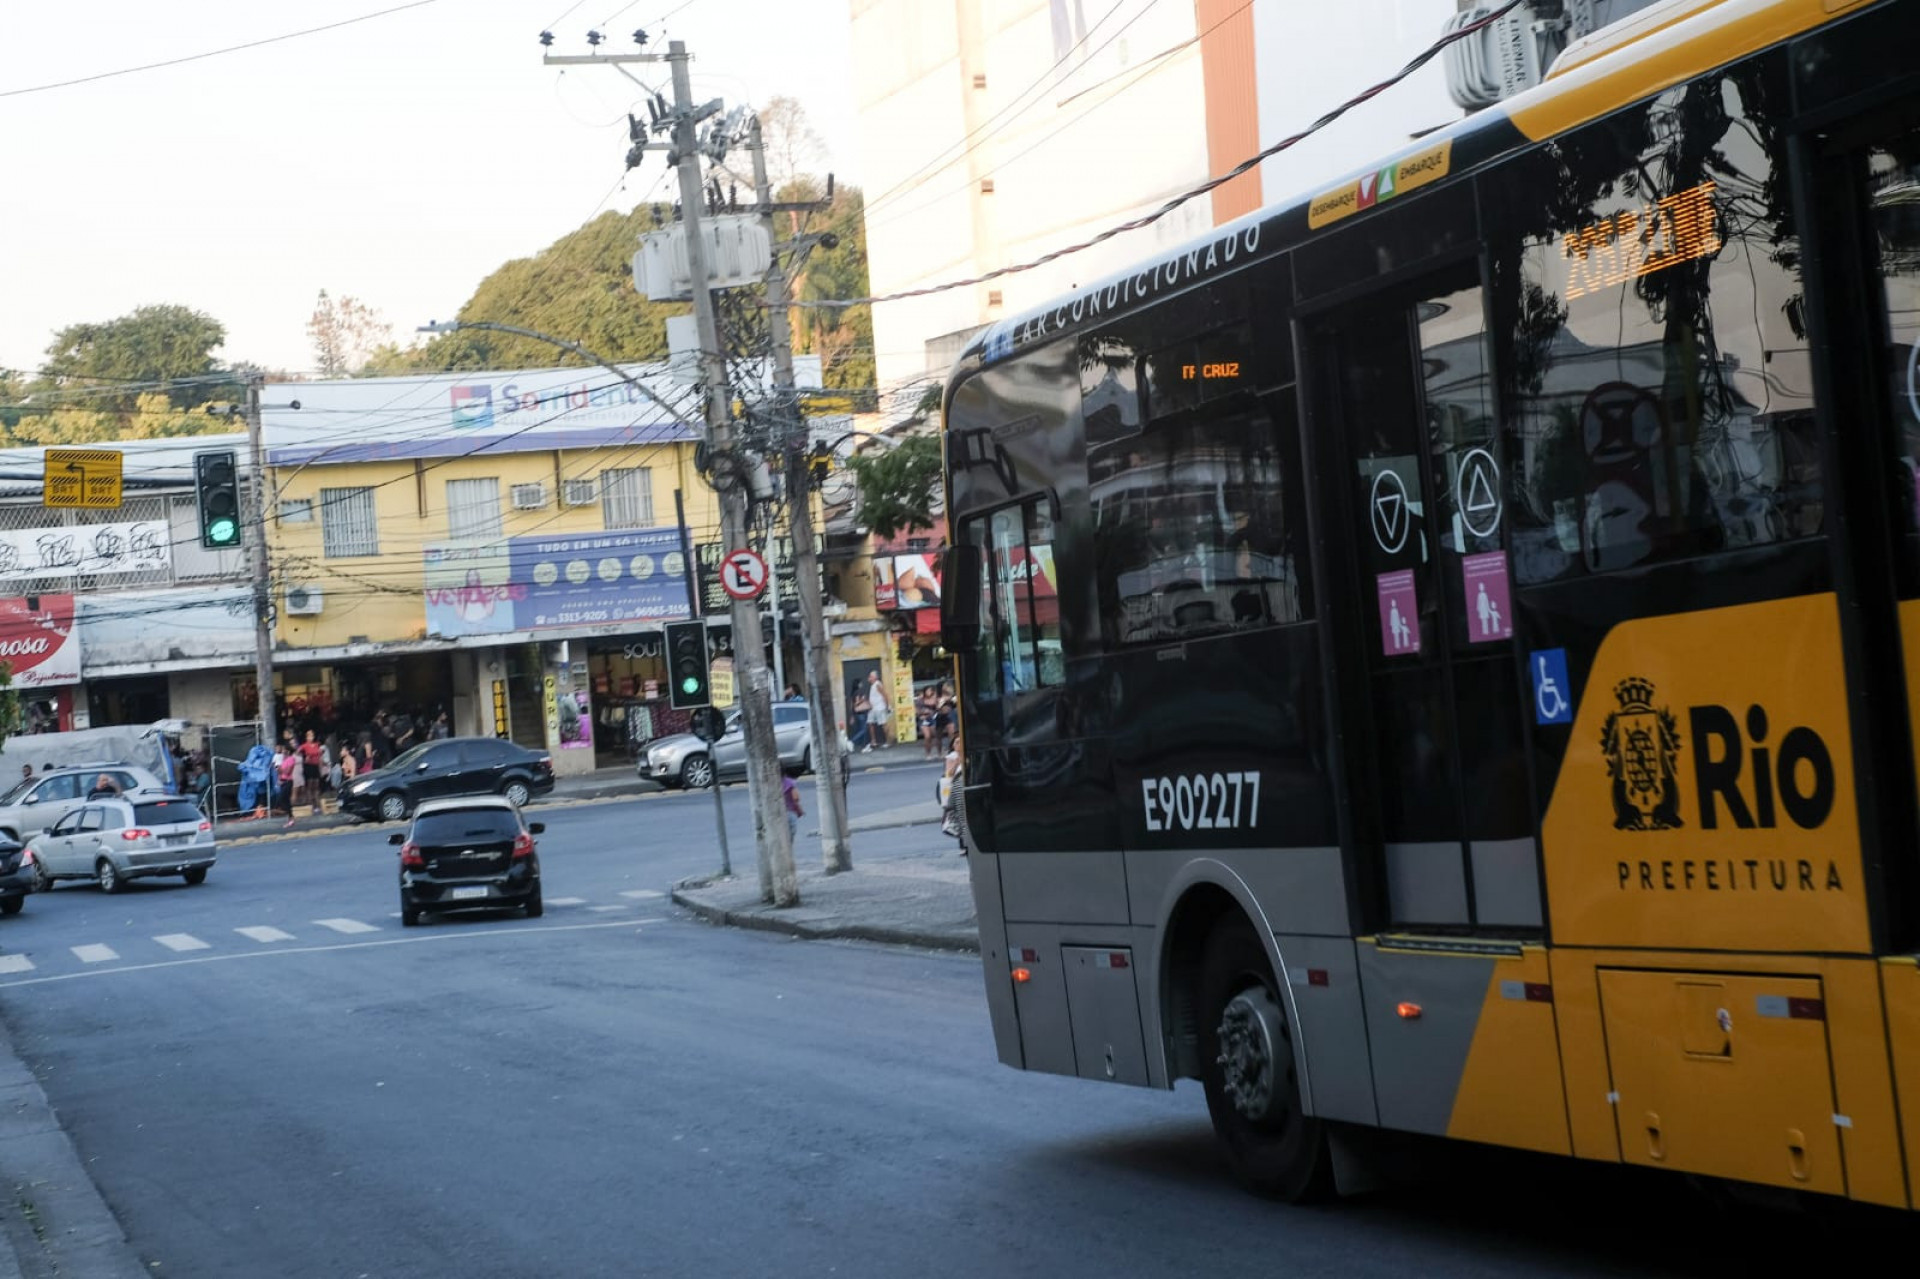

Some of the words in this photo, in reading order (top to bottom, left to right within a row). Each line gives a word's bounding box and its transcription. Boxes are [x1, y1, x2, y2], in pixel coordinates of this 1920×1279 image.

[1400, 151, 1443, 180] EMBARQUE
[1312, 189, 1357, 218] DESEMBARQUE
[1021, 312, 1047, 343] AR
[1056, 222, 1261, 328] CONDICIONADO
[1202, 363, 1240, 378] CRUZ
[537, 543, 569, 553] TUDO
[574, 541, 589, 551] EM
[593, 539, 611, 549] UM
[1689, 703, 1836, 831] Rio
[1142, 770, 1261, 831] E902277
[1617, 859, 1844, 892] PREFEITURA
